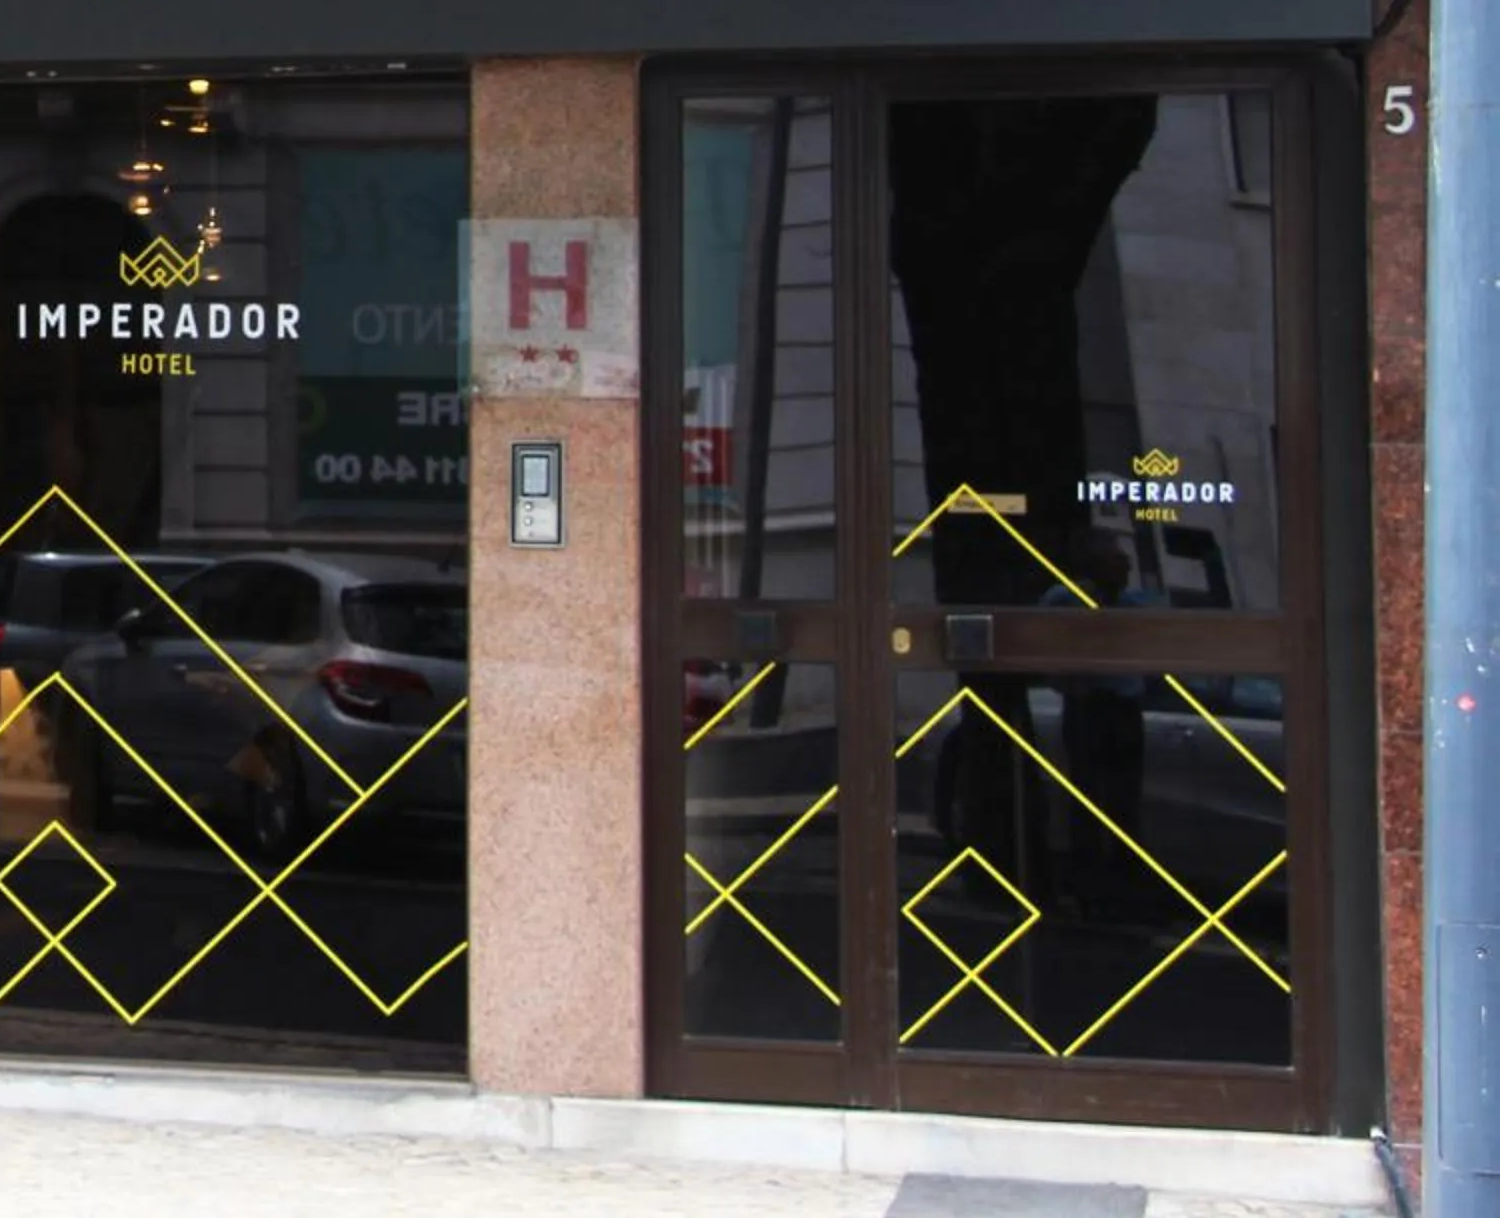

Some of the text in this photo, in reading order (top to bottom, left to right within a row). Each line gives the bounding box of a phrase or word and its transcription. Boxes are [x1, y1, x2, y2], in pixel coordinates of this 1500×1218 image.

[509, 241, 588, 330] H
[18, 303, 301, 340] IMPERADOR
[121, 353, 196, 375] HOTEL
[1077, 481, 1235, 503] IMPERADOR
[1136, 509, 1178, 521] HOTEL
